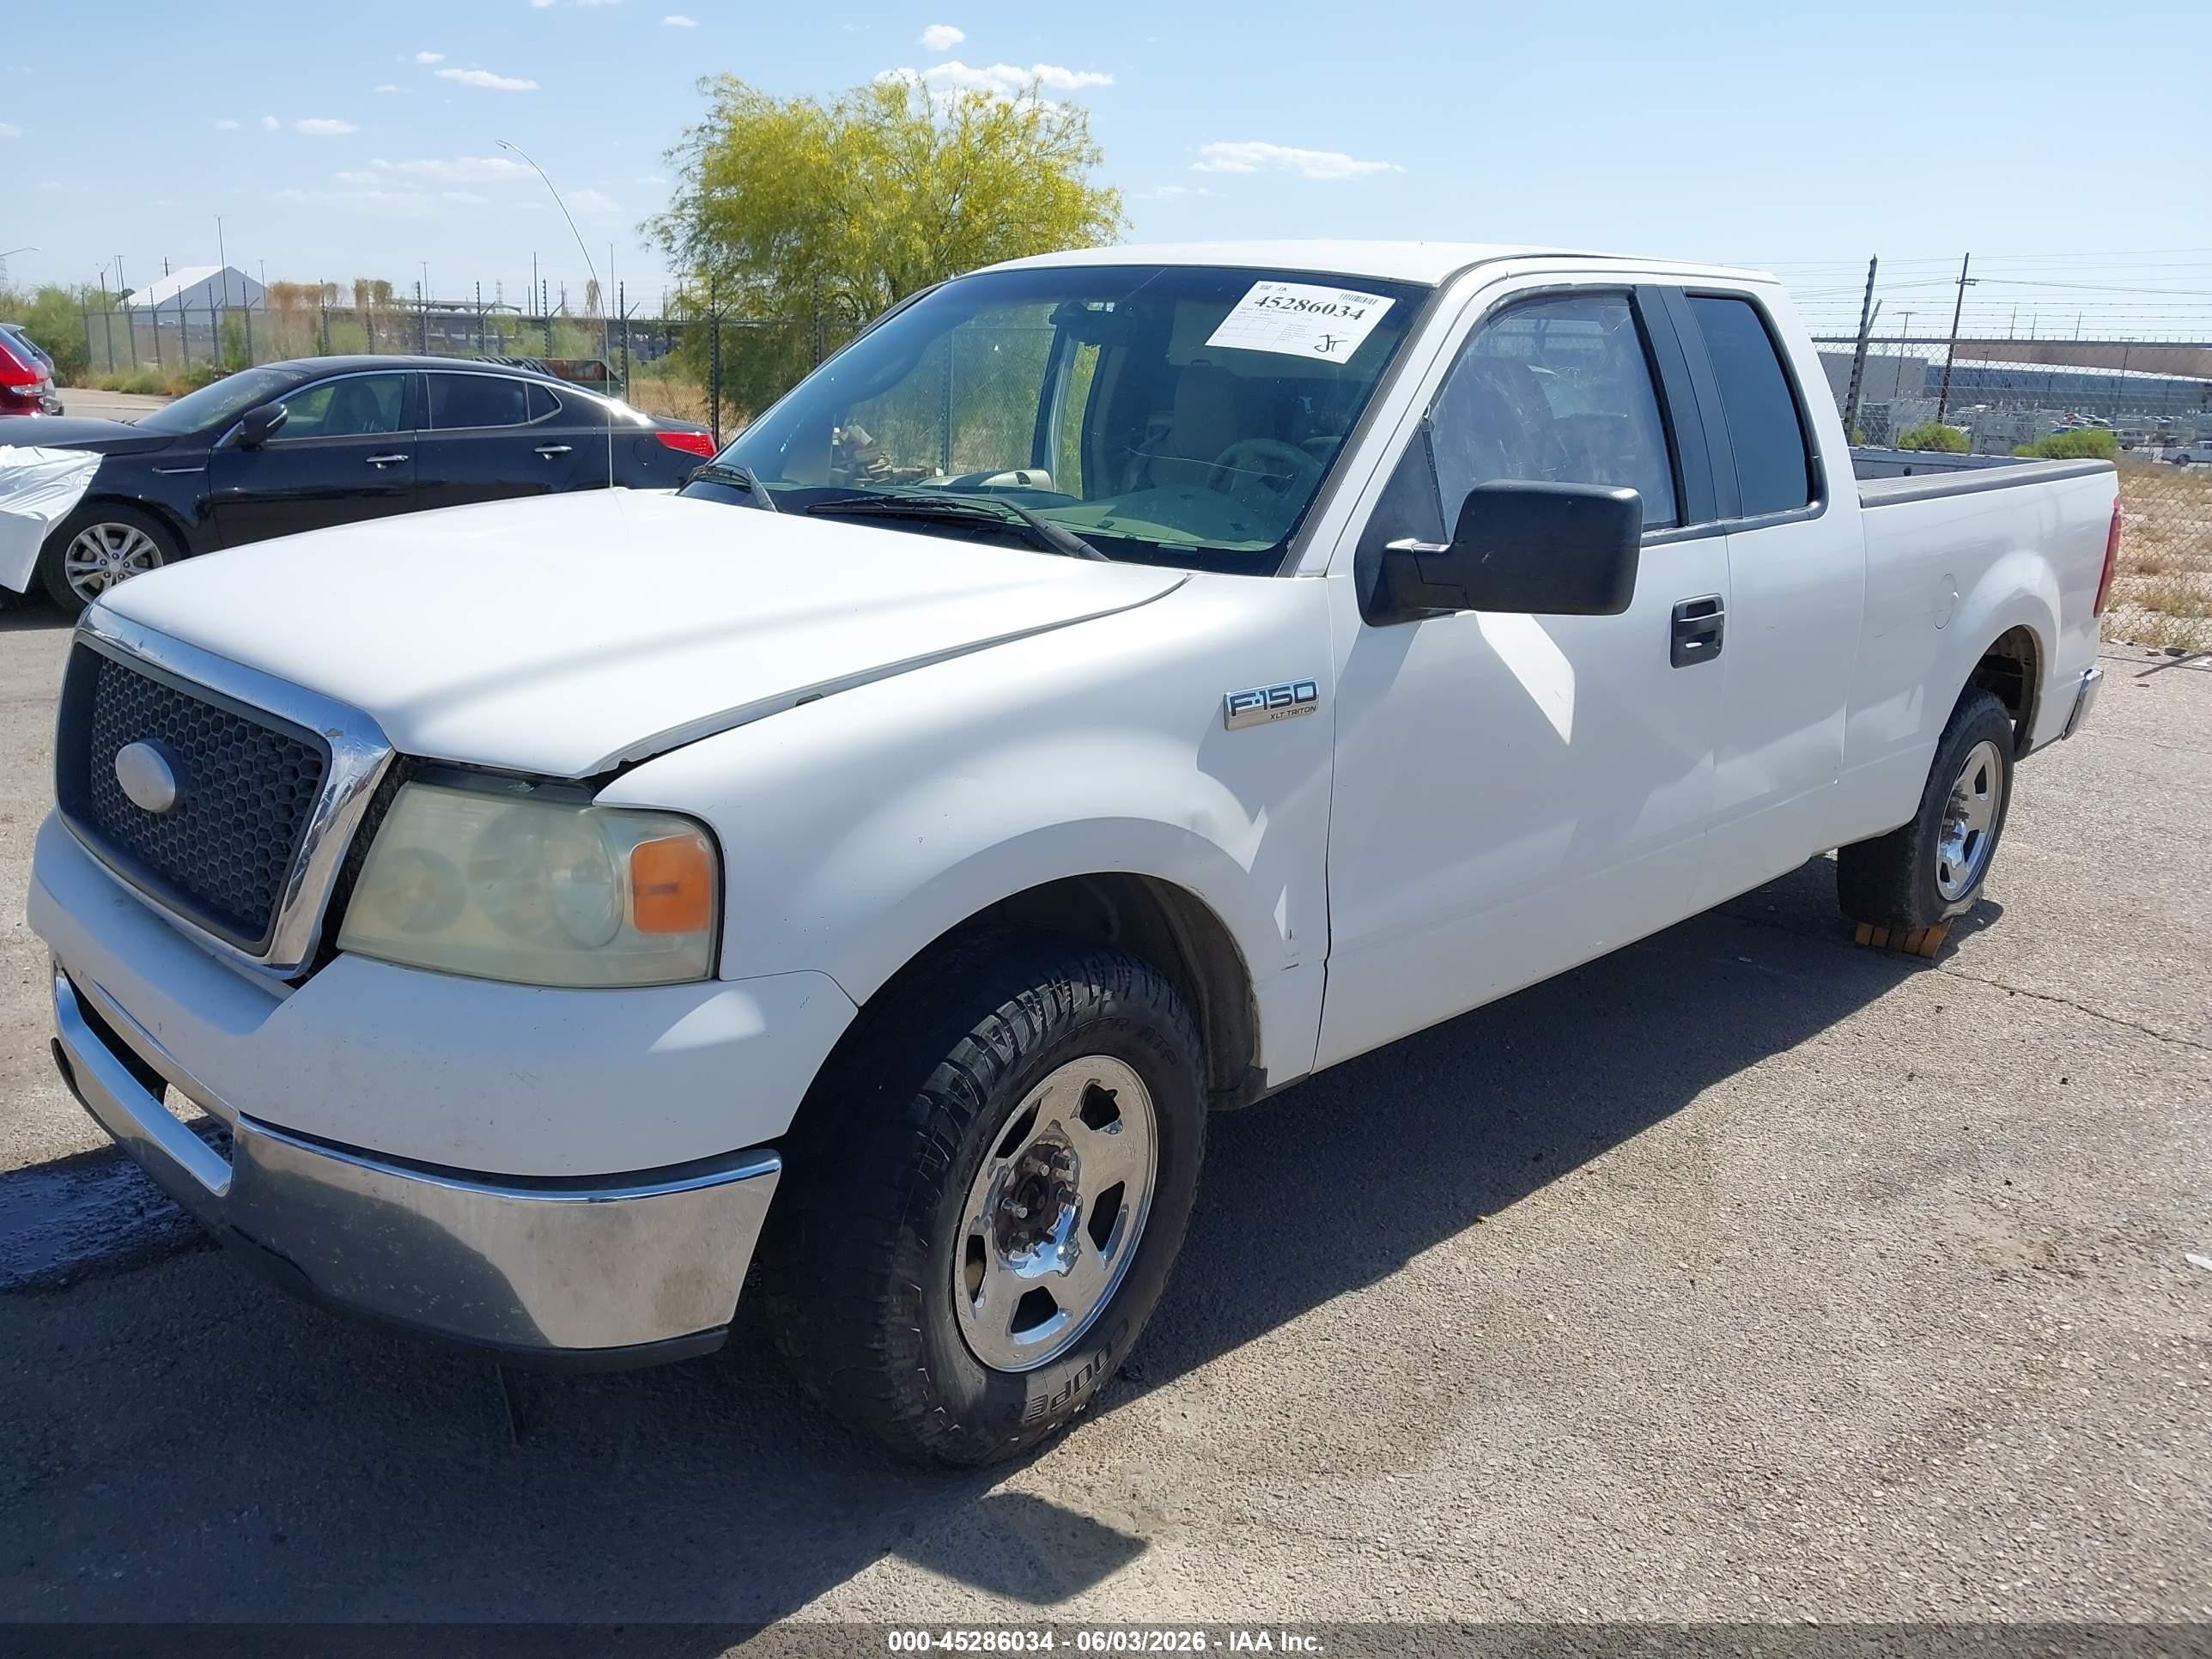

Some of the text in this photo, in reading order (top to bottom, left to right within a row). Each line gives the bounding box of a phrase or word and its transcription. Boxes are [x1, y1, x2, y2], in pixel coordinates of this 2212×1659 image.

[1254, 295, 1366, 321] 45286034
[1270, 706, 1316, 720] XLT TRITON
